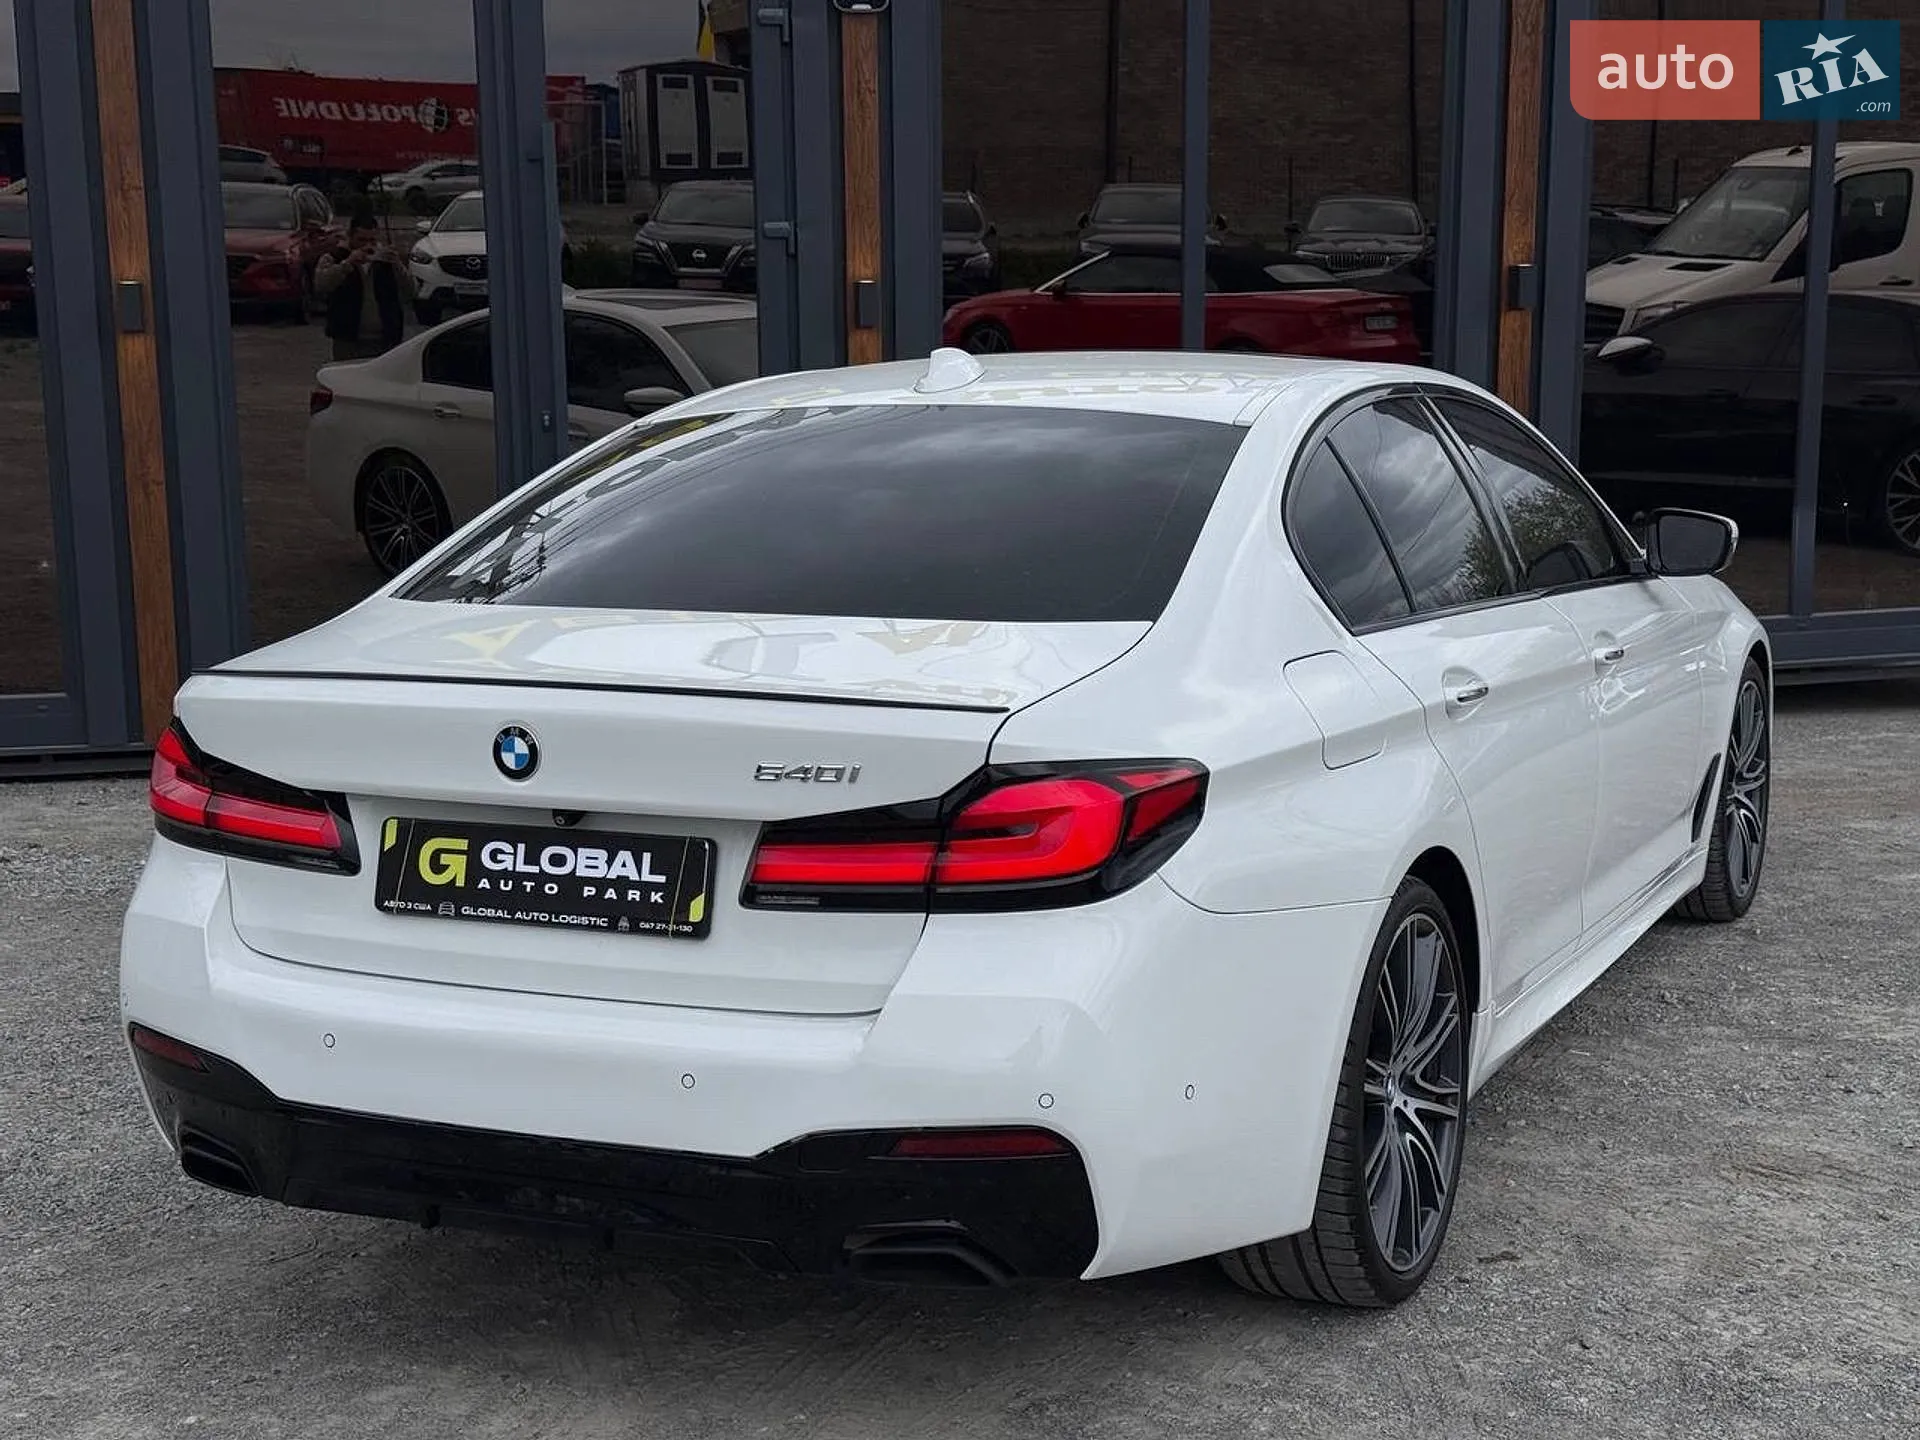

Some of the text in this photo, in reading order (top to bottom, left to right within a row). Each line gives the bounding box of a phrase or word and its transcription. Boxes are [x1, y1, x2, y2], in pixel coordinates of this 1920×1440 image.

[480, 841, 667, 883] GLOBAL
[477, 878, 665, 903] AUTO PARK
[461, 905, 609, 927] GLOBAL AUTO LOGISTIC
